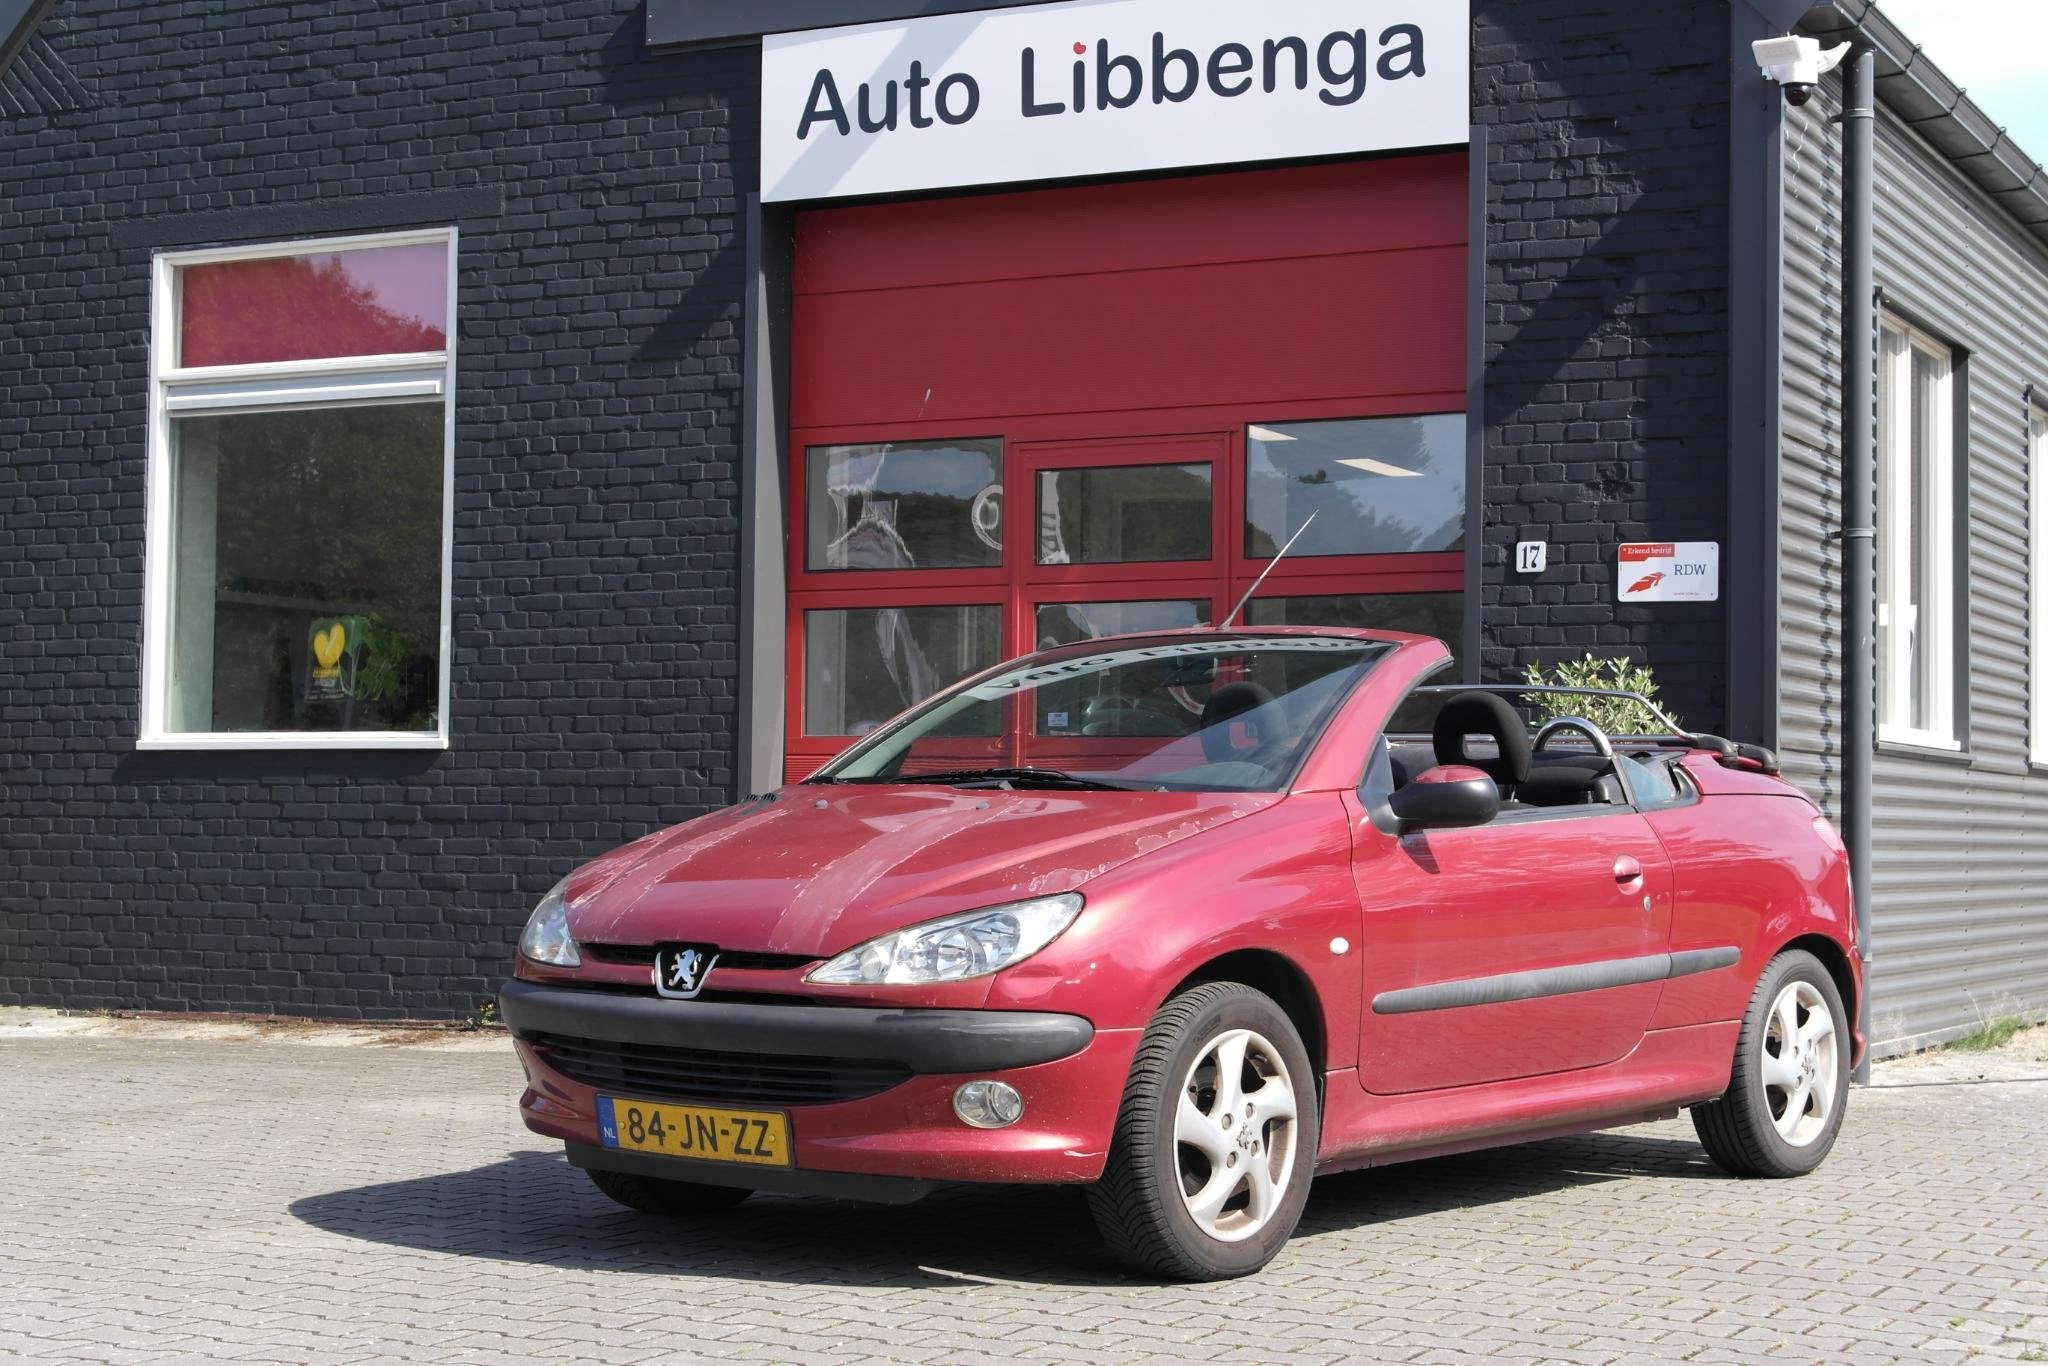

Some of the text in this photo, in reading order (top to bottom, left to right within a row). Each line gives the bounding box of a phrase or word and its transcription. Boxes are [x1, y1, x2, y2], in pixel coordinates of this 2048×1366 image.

[797, 23, 1426, 140] Auto Libbenga
[1521, 545, 1540, 568] 17
[1627, 547, 1650, 555] Erkend
[1674, 564, 1706, 576] RDW
[603, 1127, 616, 1139] NL
[627, 1107, 773, 1157] 84-JN-ZZ
